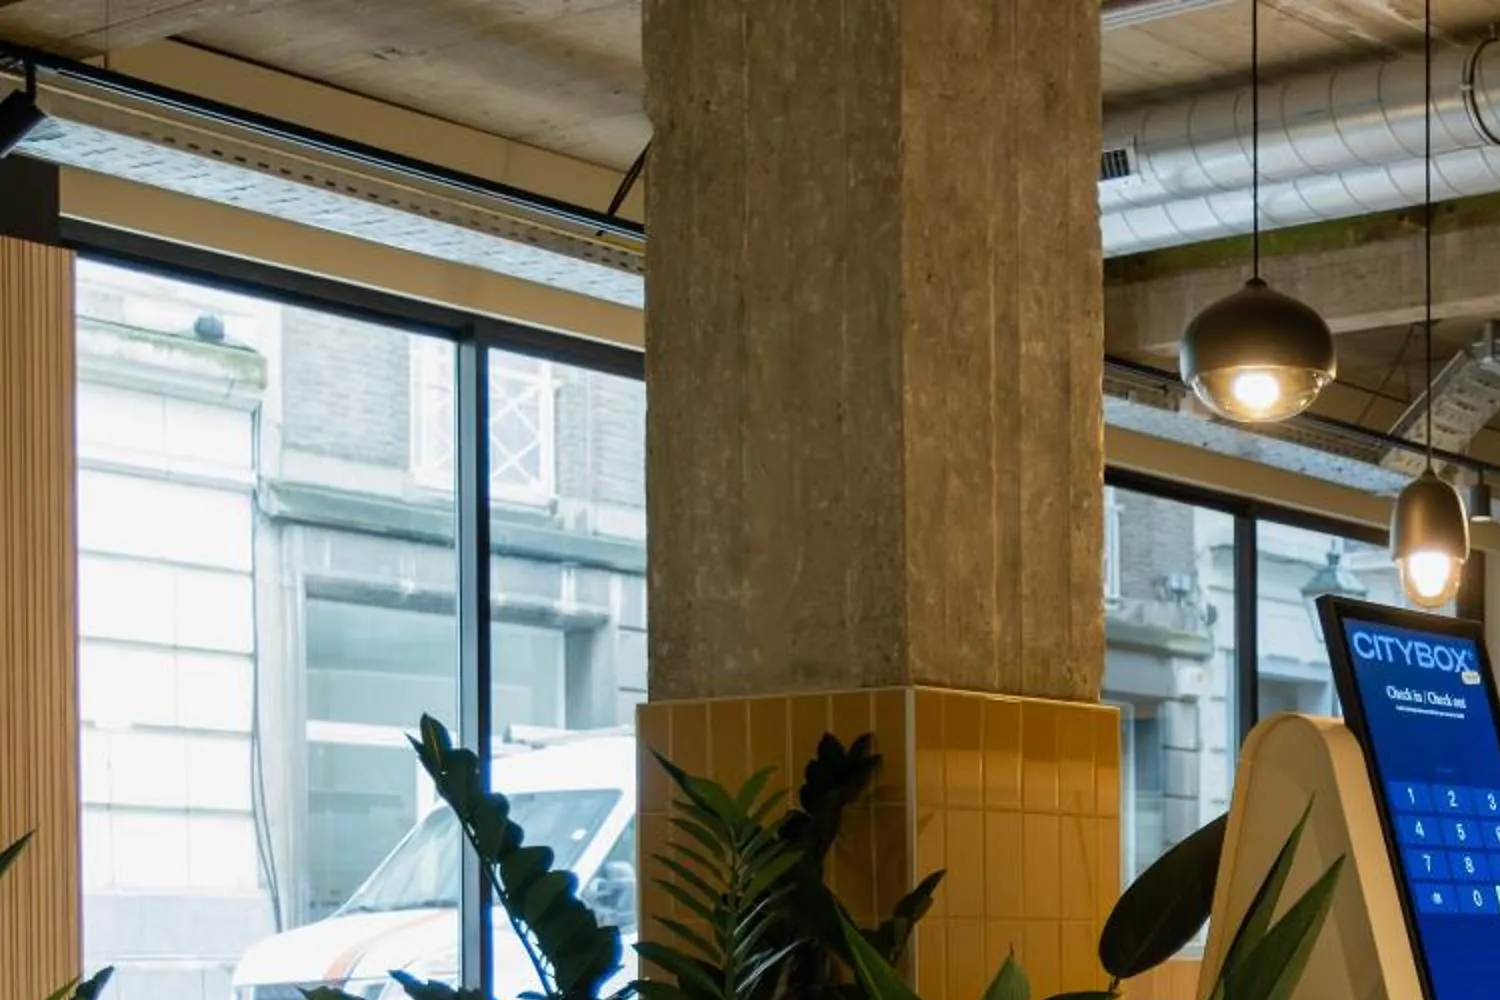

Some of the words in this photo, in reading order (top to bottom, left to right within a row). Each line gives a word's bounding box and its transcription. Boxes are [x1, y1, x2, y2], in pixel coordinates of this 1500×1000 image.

[1352, 631, 1471, 673] CITYBOX
[1407, 787, 1415, 805] 1
[1447, 789, 1459, 807] 2
[1487, 792, 1497, 811] 3
[1415, 820, 1425, 838] 4
[1455, 823, 1466, 841] 5
[1422, 853, 1431, 873] 7
[1464, 856, 1475, 875] 8
[1473, 888, 1483, 907] 0
